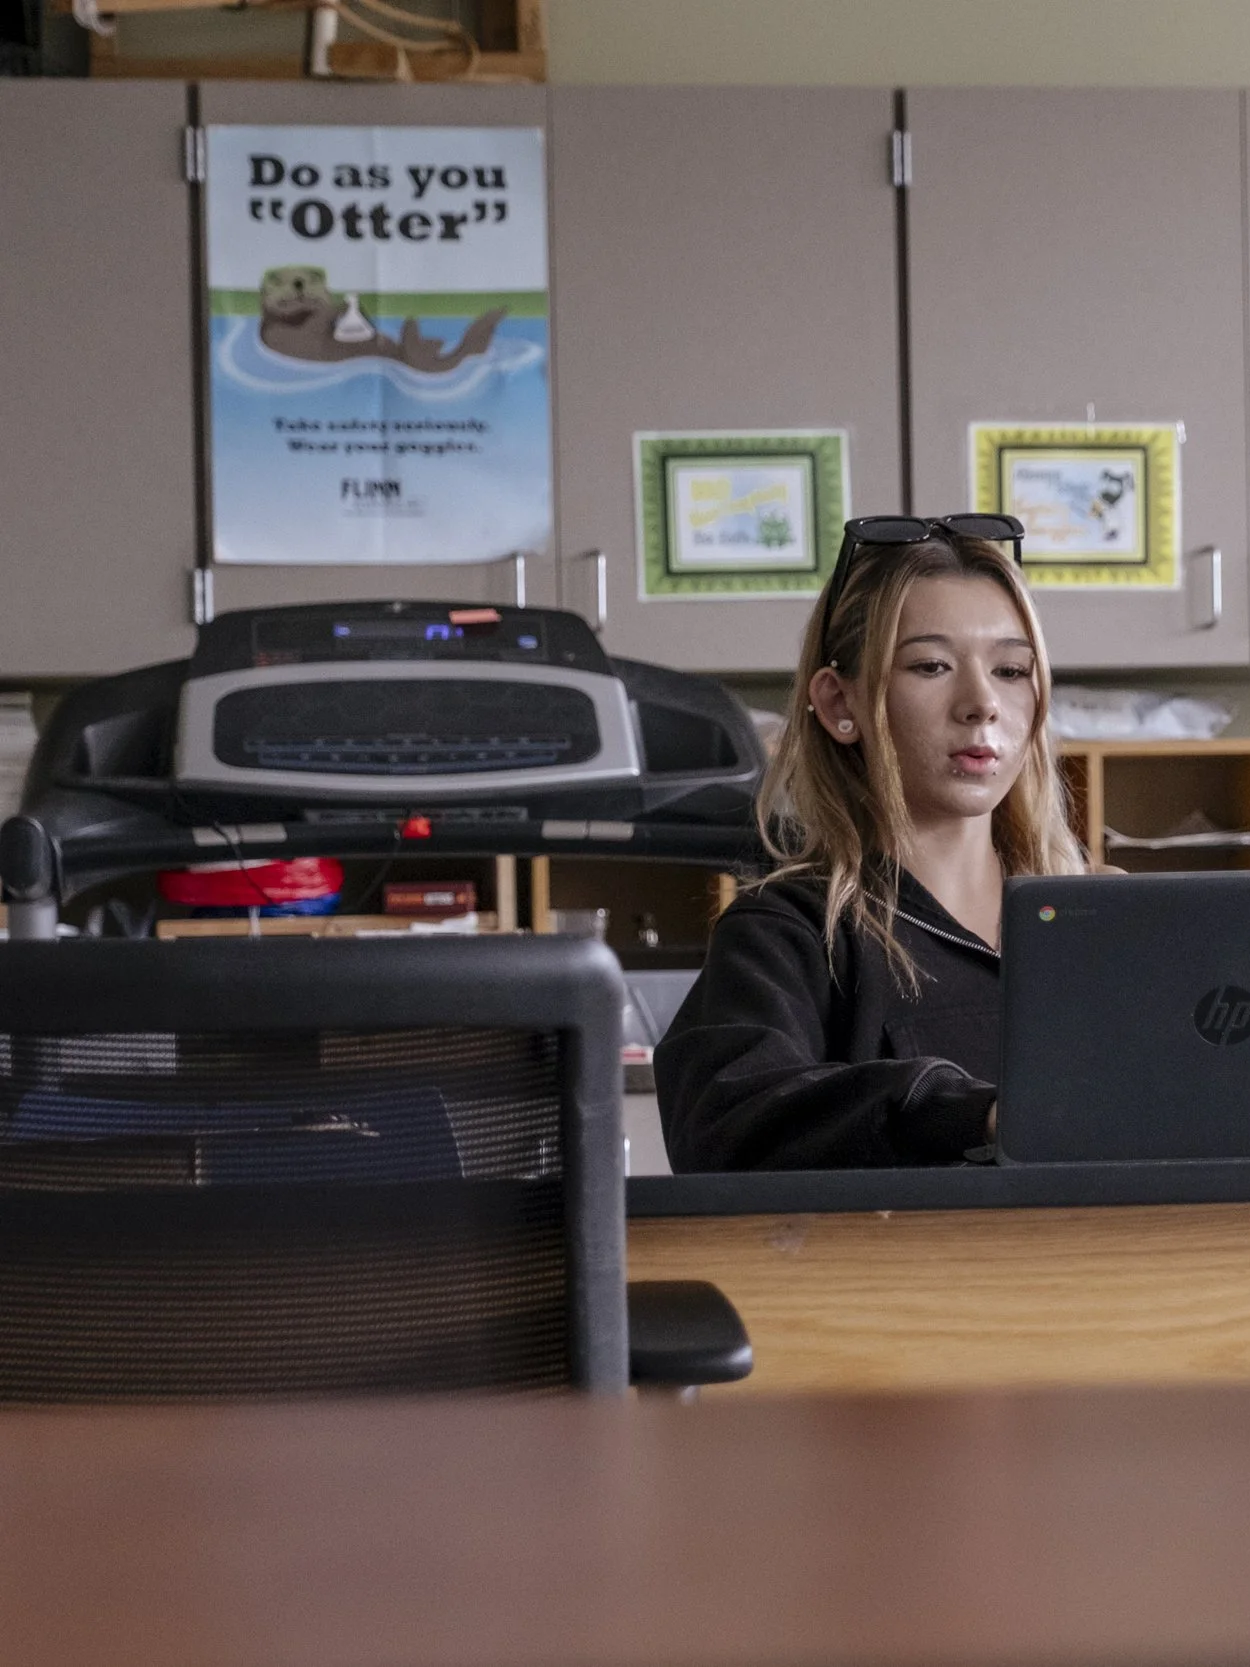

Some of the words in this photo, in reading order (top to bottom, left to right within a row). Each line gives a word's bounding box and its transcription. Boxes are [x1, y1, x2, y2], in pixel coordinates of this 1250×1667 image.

[250, 155, 320, 188] Do
[333, 164, 391, 189] as
[406, 164, 506, 199] you
[250, 200, 508, 241] “Otter”
